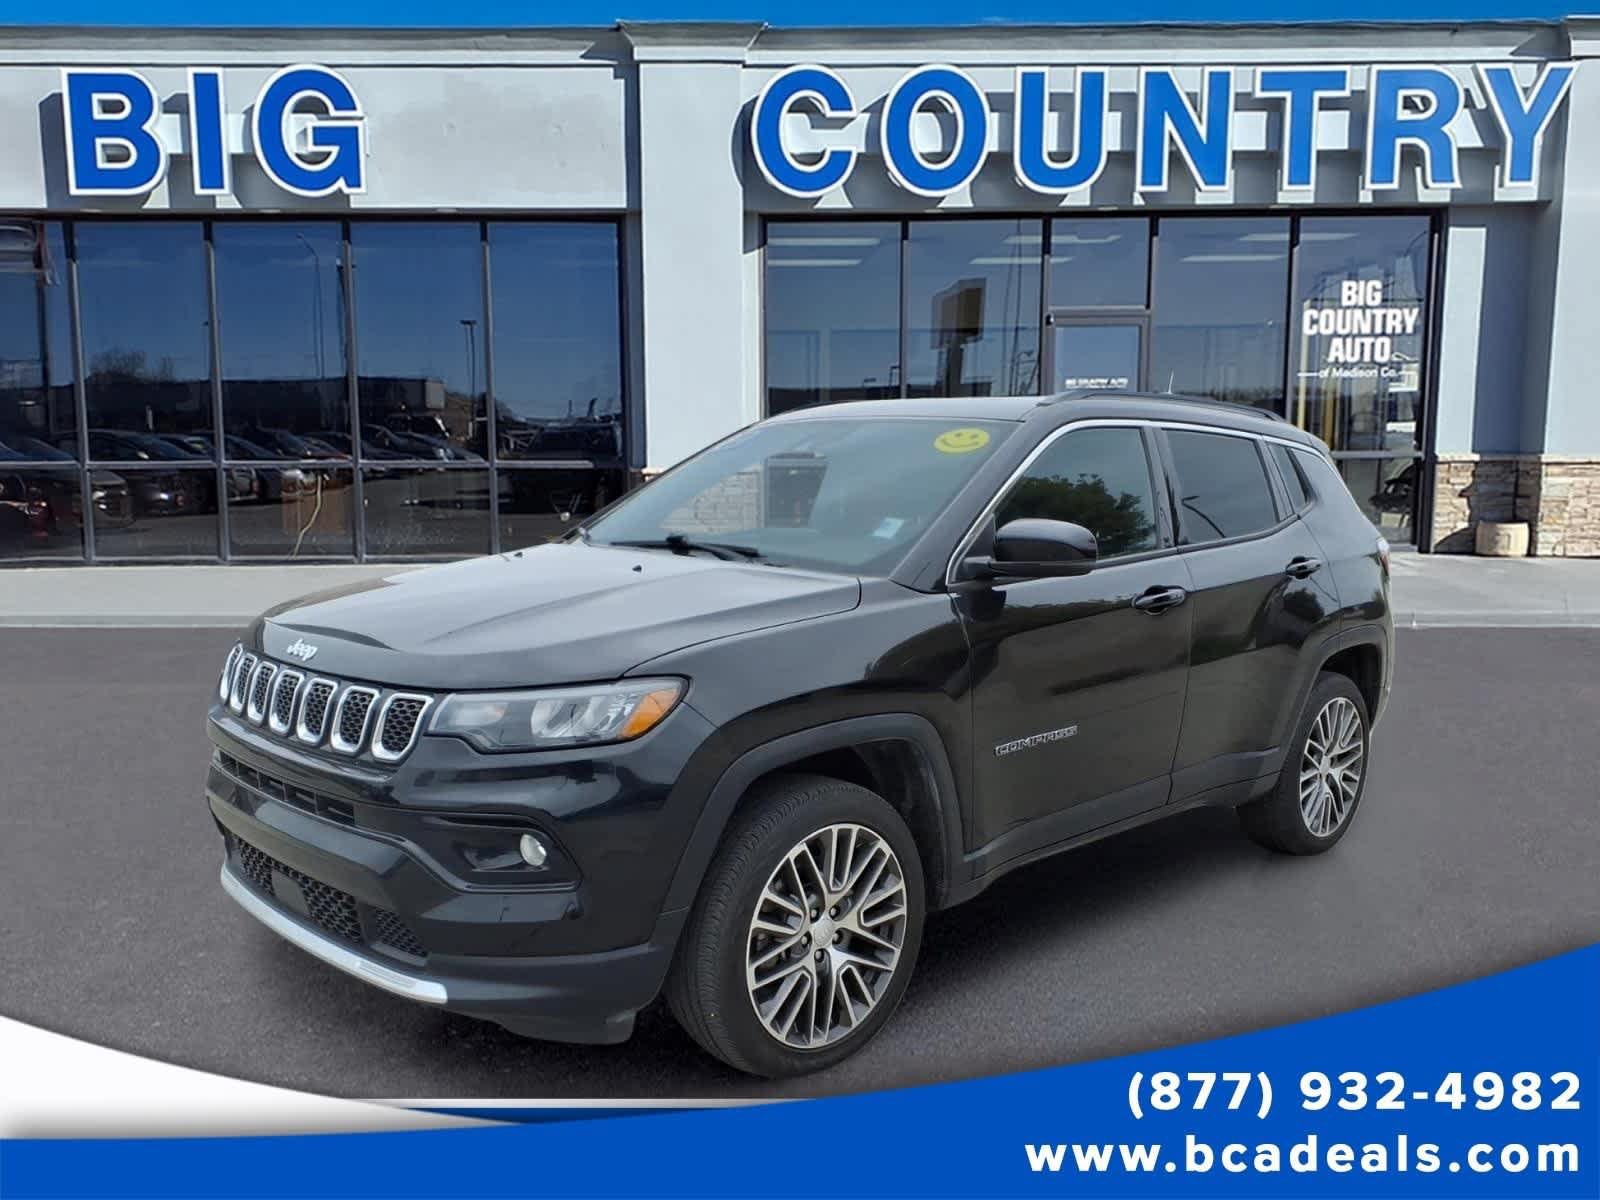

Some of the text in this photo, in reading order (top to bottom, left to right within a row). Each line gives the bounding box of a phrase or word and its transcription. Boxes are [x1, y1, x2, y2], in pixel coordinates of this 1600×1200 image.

[61, 63, 1577, 199] BIG COUNTRY
[1341, 279, 1383, 307] BIG
[1302, 307, 1420, 337] COUNTRY
[1327, 337, 1392, 364] AUTO
[286, 637, 318, 662] Jeep
[995, 725, 1078, 756] COMPASS
